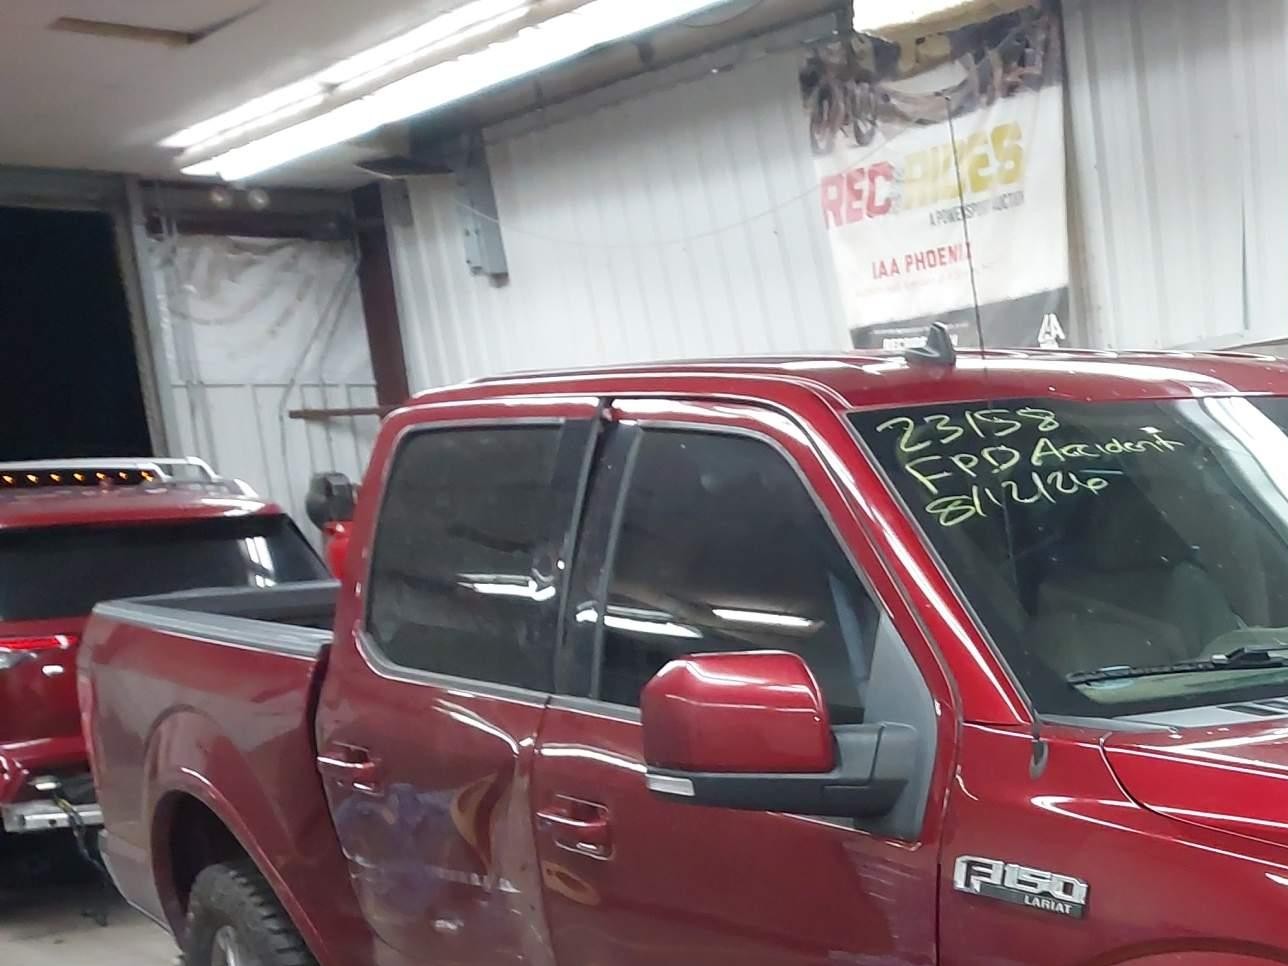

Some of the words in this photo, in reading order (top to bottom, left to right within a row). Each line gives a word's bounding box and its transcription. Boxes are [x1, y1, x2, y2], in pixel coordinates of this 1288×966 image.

[820, 161, 895, 230] REC
[872, 257, 901, 279] IAA
[904, 444, 1022, 495] FPD
[1030, 432, 1186, 467] Accident
[925, 472, 1110, 527] 8/12/26
[1024, 894, 1073, 914] LARIAT
